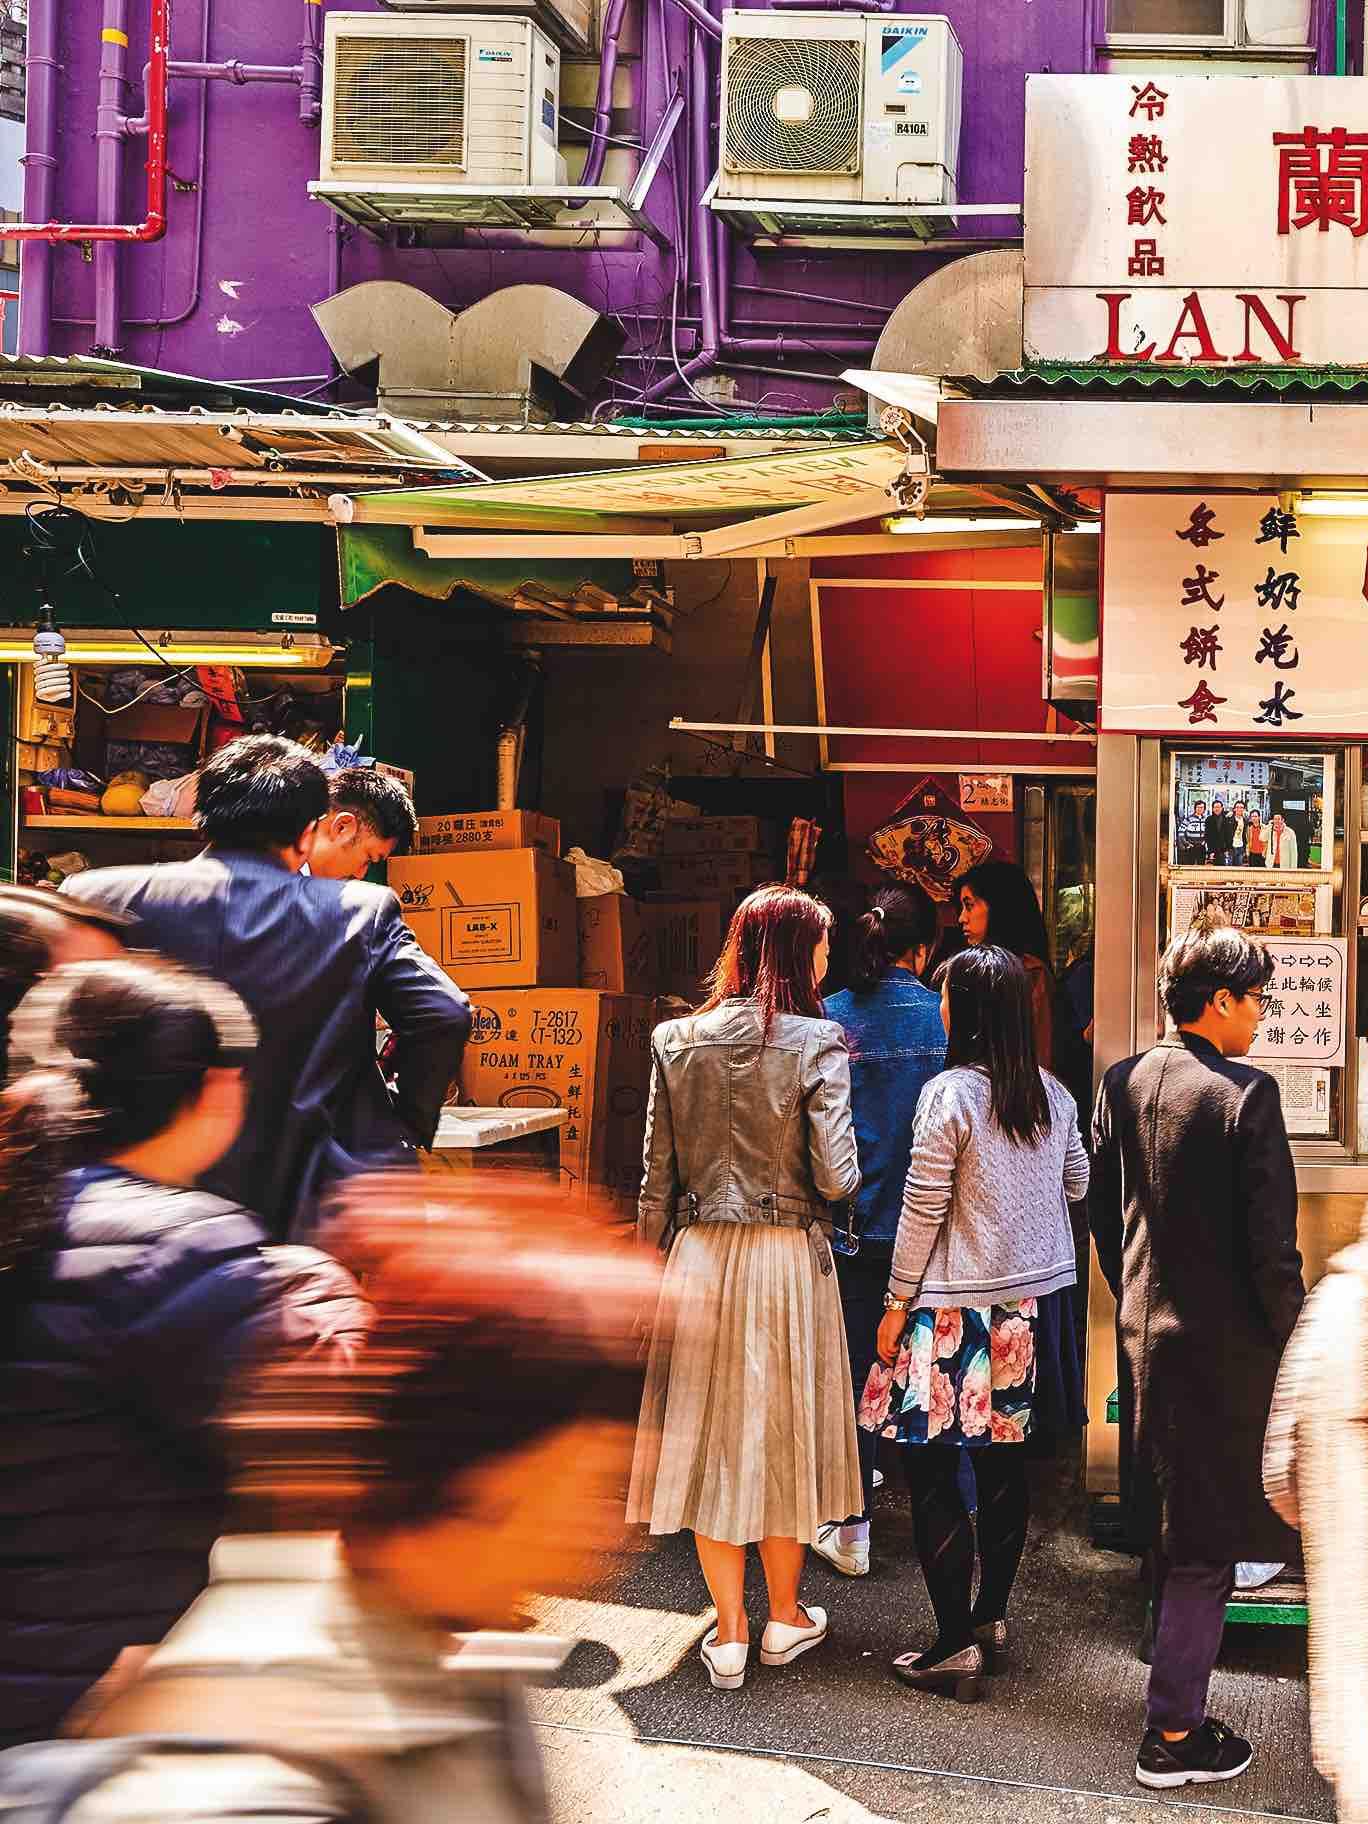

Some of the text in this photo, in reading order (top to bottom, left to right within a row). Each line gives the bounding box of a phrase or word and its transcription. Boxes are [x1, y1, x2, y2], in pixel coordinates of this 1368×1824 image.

[881, 27, 928, 35] DAIKIN
[896, 124, 927, 134] R410A
[1126, 82, 1168, 276] 冷熱飲品
[1096, 292, 1306, 363] LAN
[1176, 502, 1228, 724] 各式餅食
[963, 783, 976, 804] 2
[437, 821, 450, 833] 20
[533, 1010, 579, 1027] T-2617
[531, 1028, 583, 1046] (T-132)
[1251, 1026, 1332, 1047] 謝合作
[480, 1052, 564, 1070] FOAM TRAY
